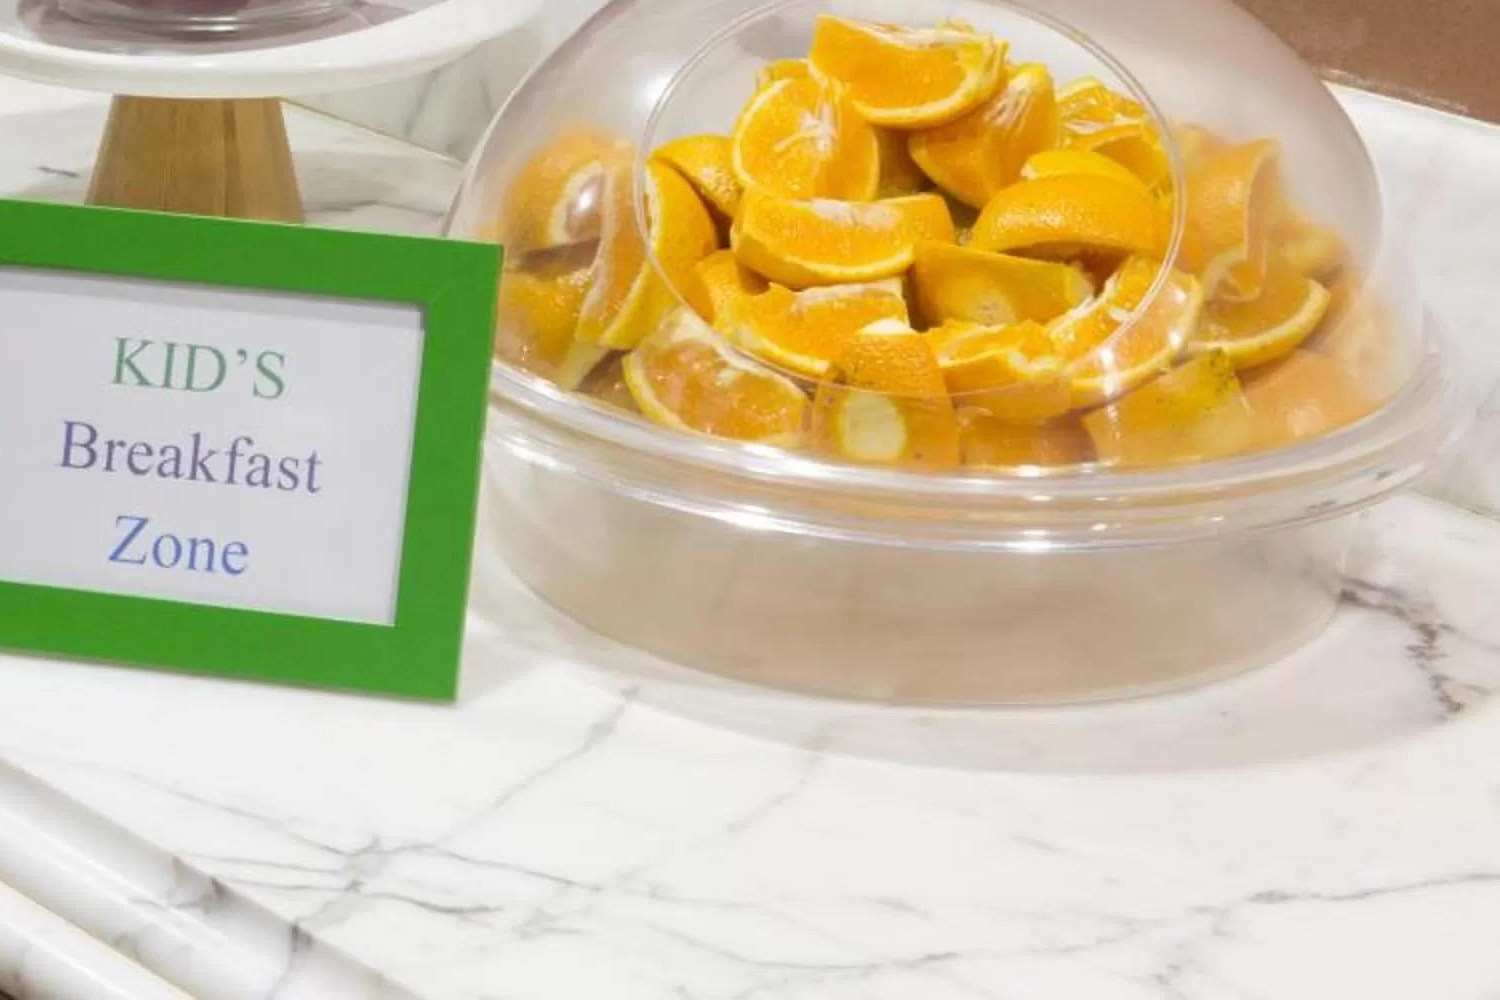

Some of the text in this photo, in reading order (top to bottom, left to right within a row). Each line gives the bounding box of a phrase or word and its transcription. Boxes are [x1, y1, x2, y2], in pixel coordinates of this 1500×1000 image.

[111, 336, 287, 400] KID'S
[59, 420, 323, 494] Breakfast
[107, 514, 249, 576] Zone
